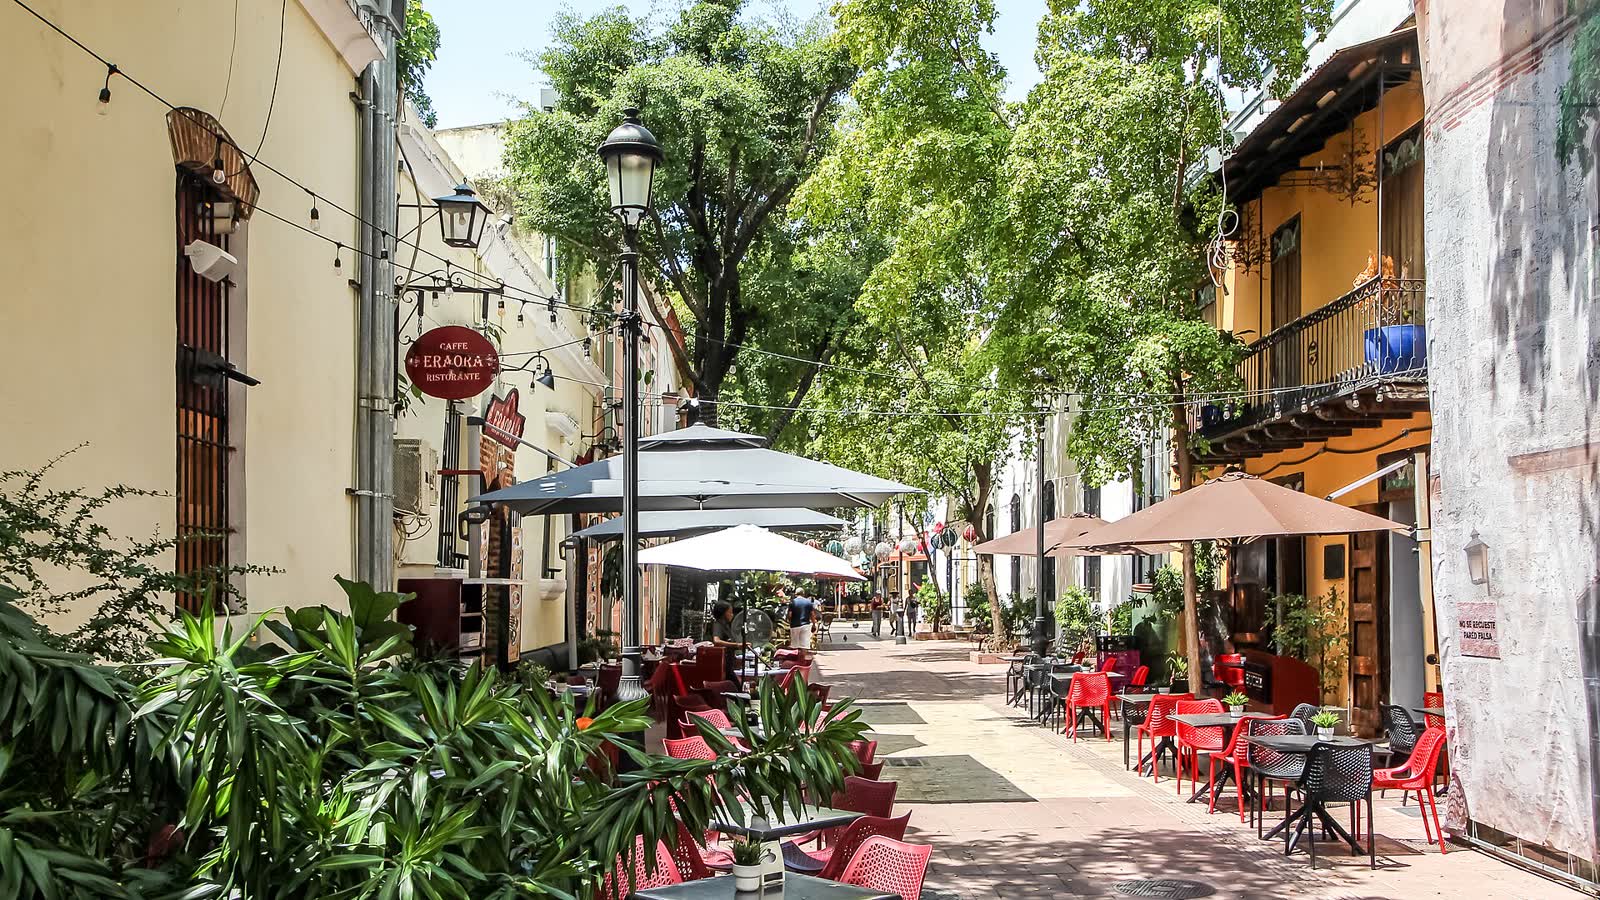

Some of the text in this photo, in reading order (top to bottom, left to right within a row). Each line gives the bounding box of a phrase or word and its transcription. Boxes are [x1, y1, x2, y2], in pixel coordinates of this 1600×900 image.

[439, 342, 469, 351] CAFFE
[425, 372, 481, 382] RISTORANTE
[1459, 620, 1466, 628] NO
[1466, 620, 1472, 628] SE
[1463, 631, 1477, 639] PARED
